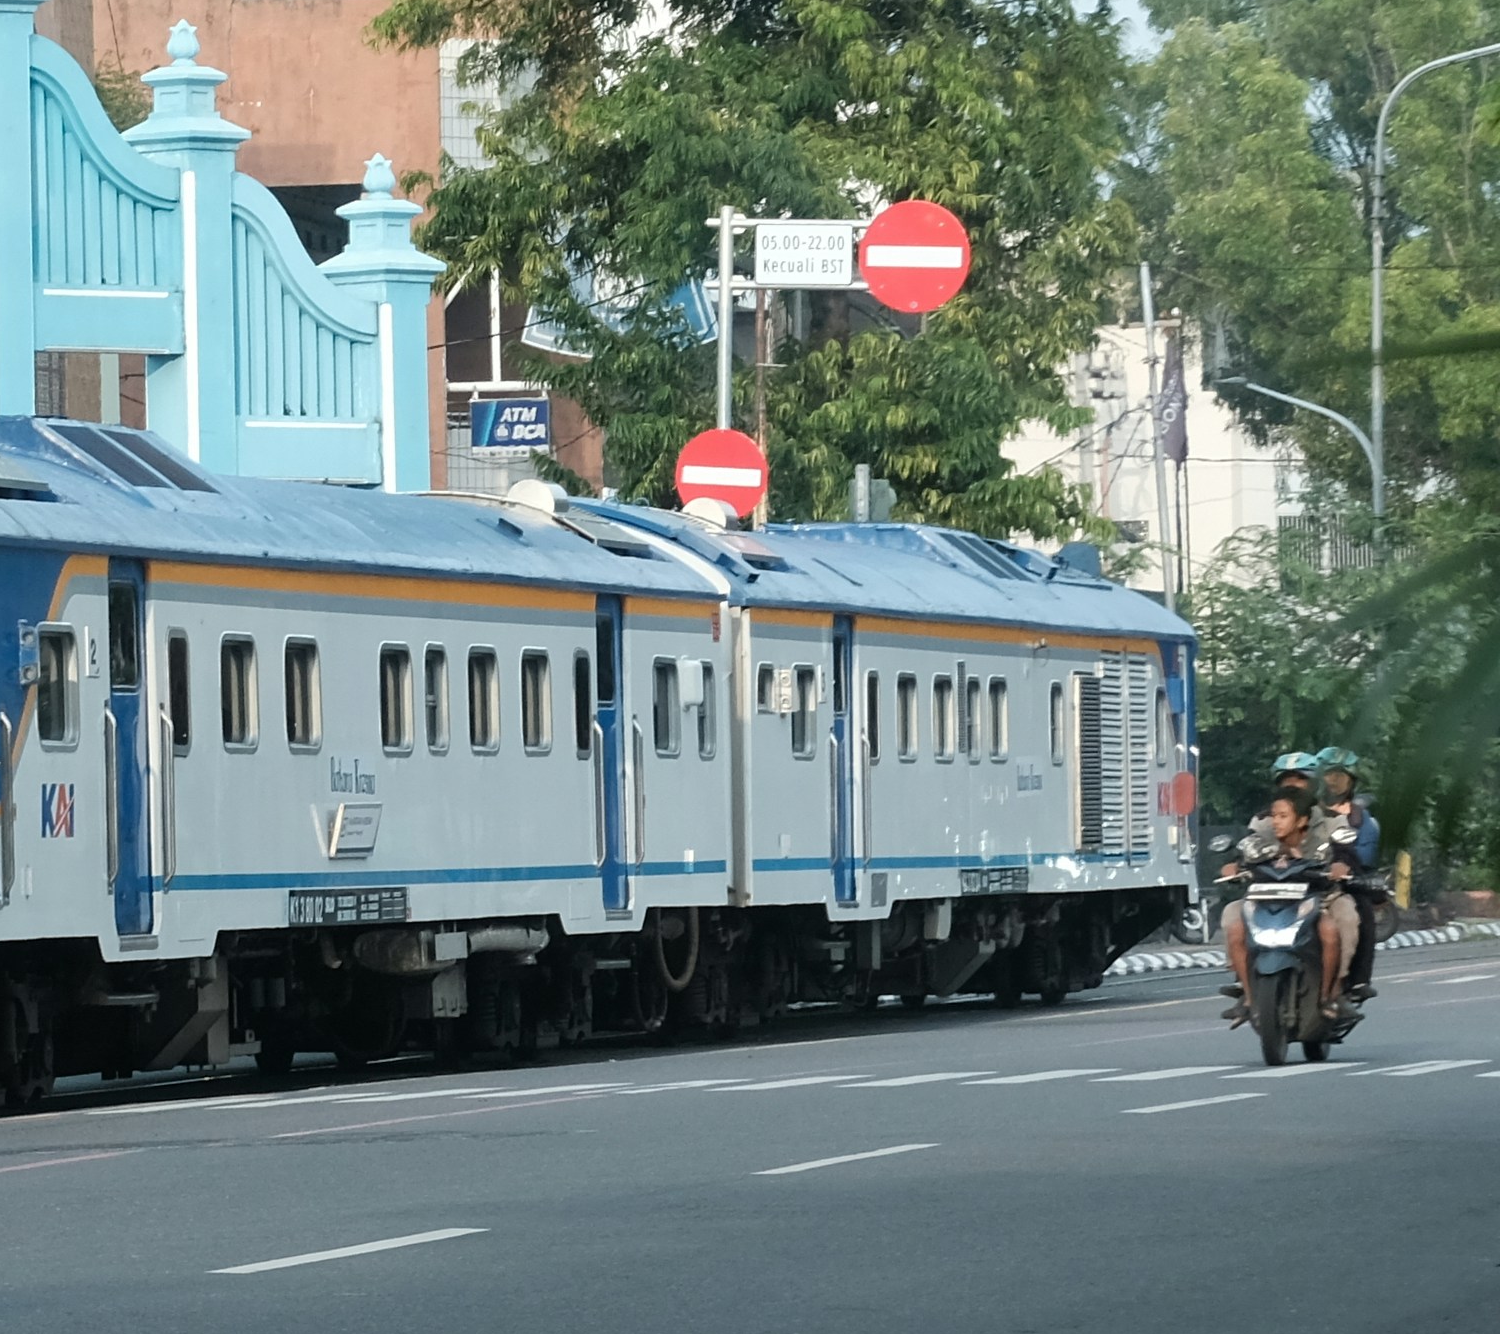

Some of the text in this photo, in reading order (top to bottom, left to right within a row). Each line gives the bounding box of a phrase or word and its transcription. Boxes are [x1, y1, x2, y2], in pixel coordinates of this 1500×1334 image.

[762, 235, 845, 251] 05.00-22.00
[763, 258, 844, 274] Kecuali BST
[499, 407, 538, 423] ATM
[90, 638, 97, 665] 2
[41, 783, 75, 838] KAI
[300, 896, 305, 923] 3
